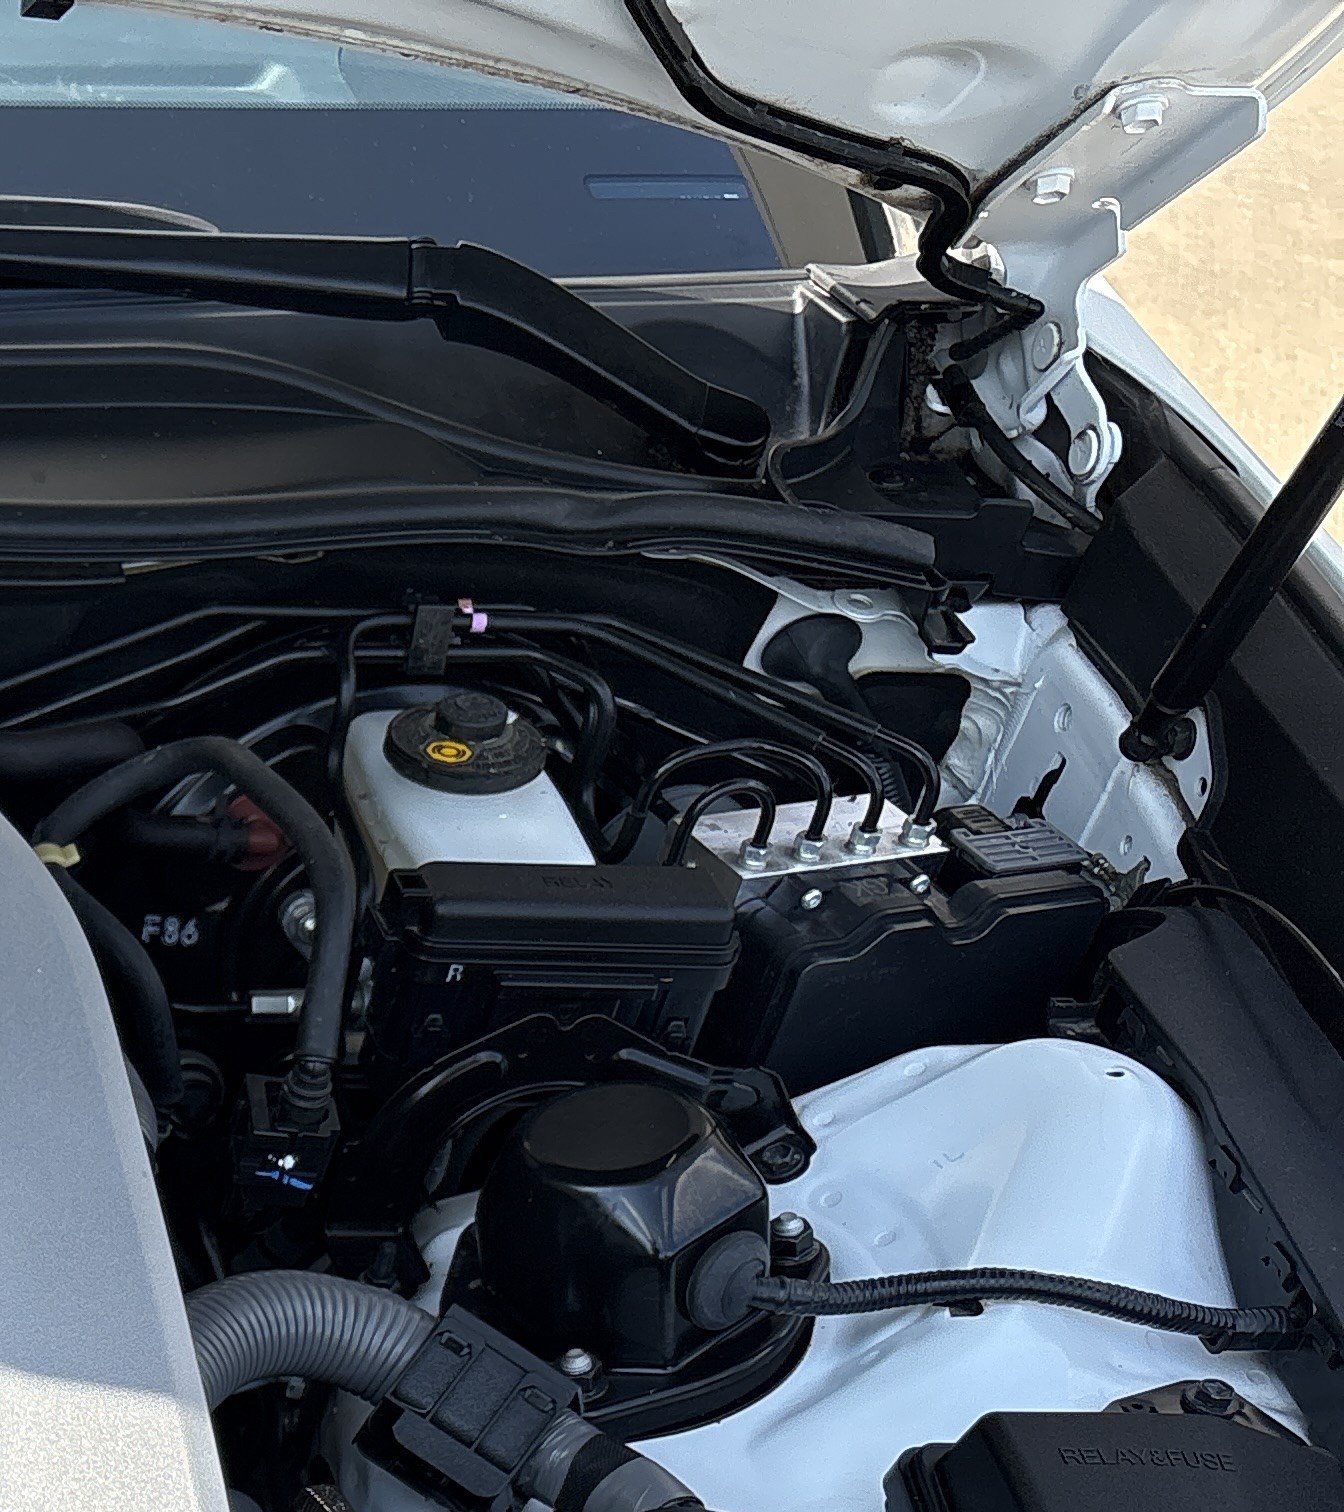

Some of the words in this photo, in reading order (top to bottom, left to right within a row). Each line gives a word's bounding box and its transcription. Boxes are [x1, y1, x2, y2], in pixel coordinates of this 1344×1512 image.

[141, 914, 199, 947] F86
[445, 963, 464, 983] R
[1057, 1447, 1238, 1473] RELAY&FUSE
